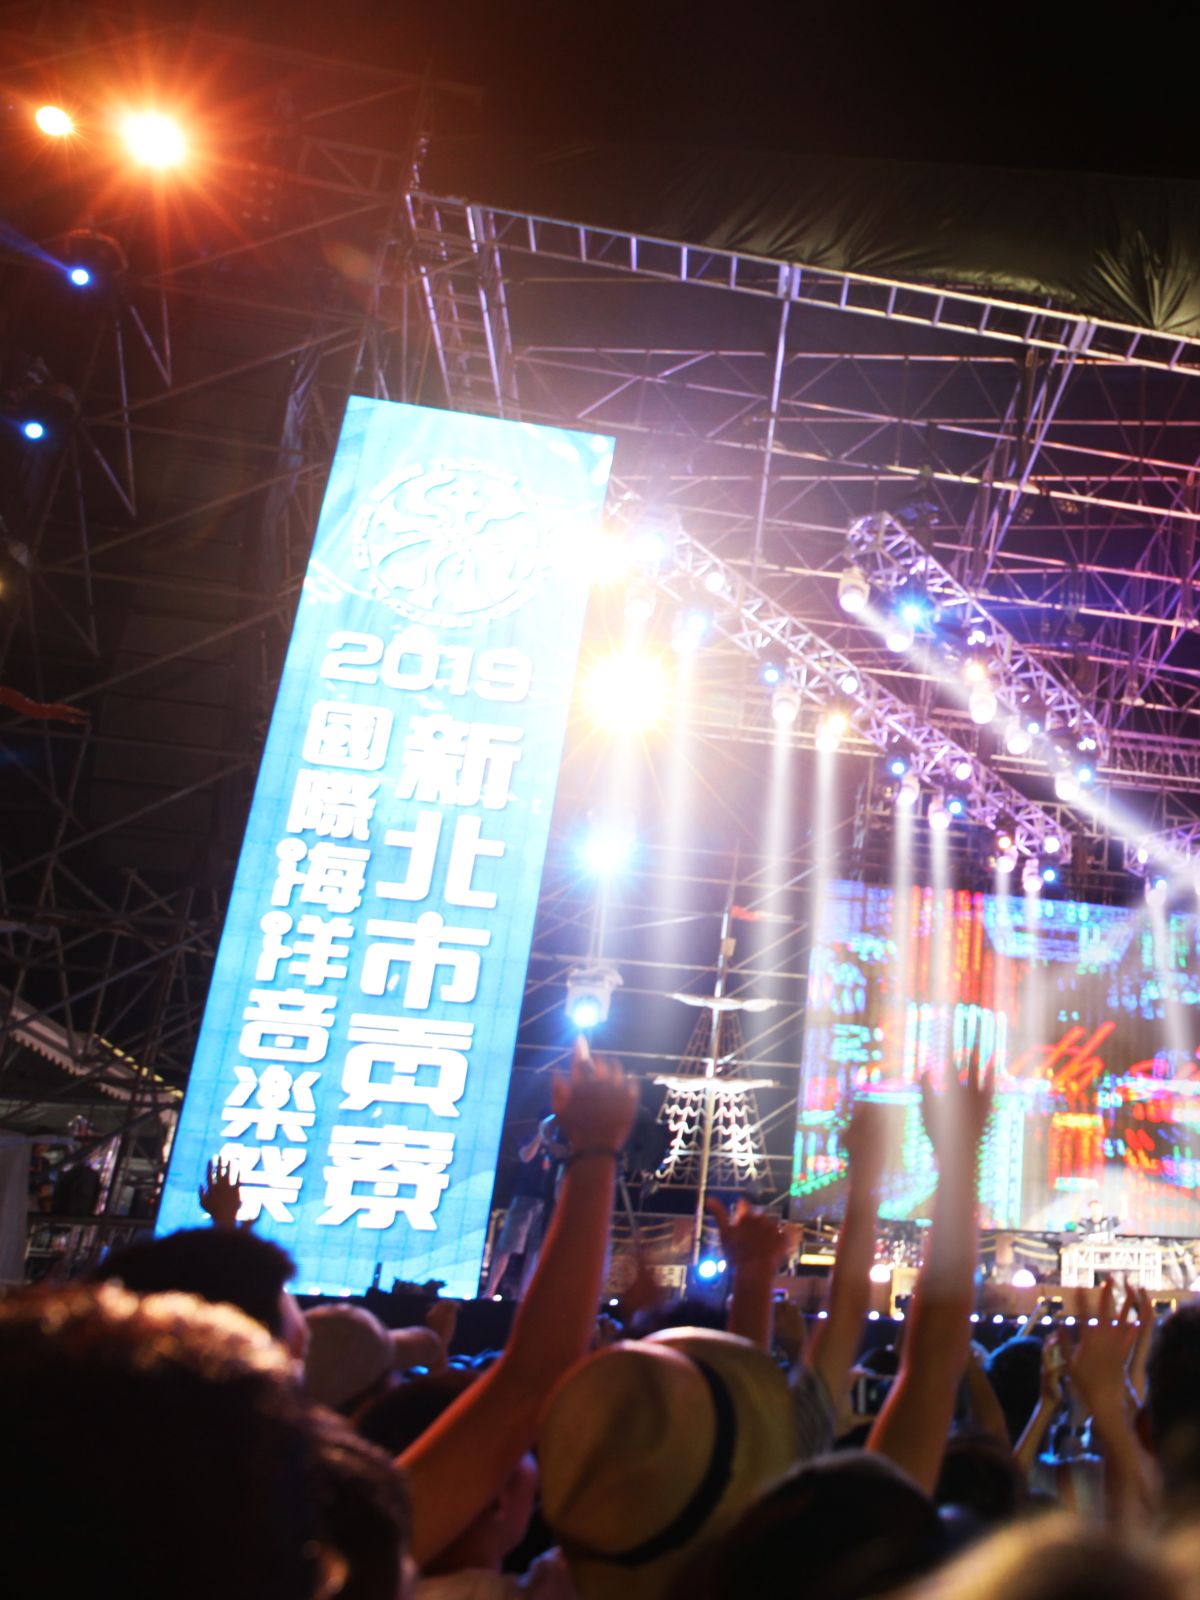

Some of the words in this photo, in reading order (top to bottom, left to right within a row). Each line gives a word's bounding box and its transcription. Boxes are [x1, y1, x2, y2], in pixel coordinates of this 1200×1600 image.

[319, 630, 533, 704] 2019
[203, 700, 395, 1225] 國際海洋音樂祭
[315, 711, 525, 1232] 新北市貢寮
